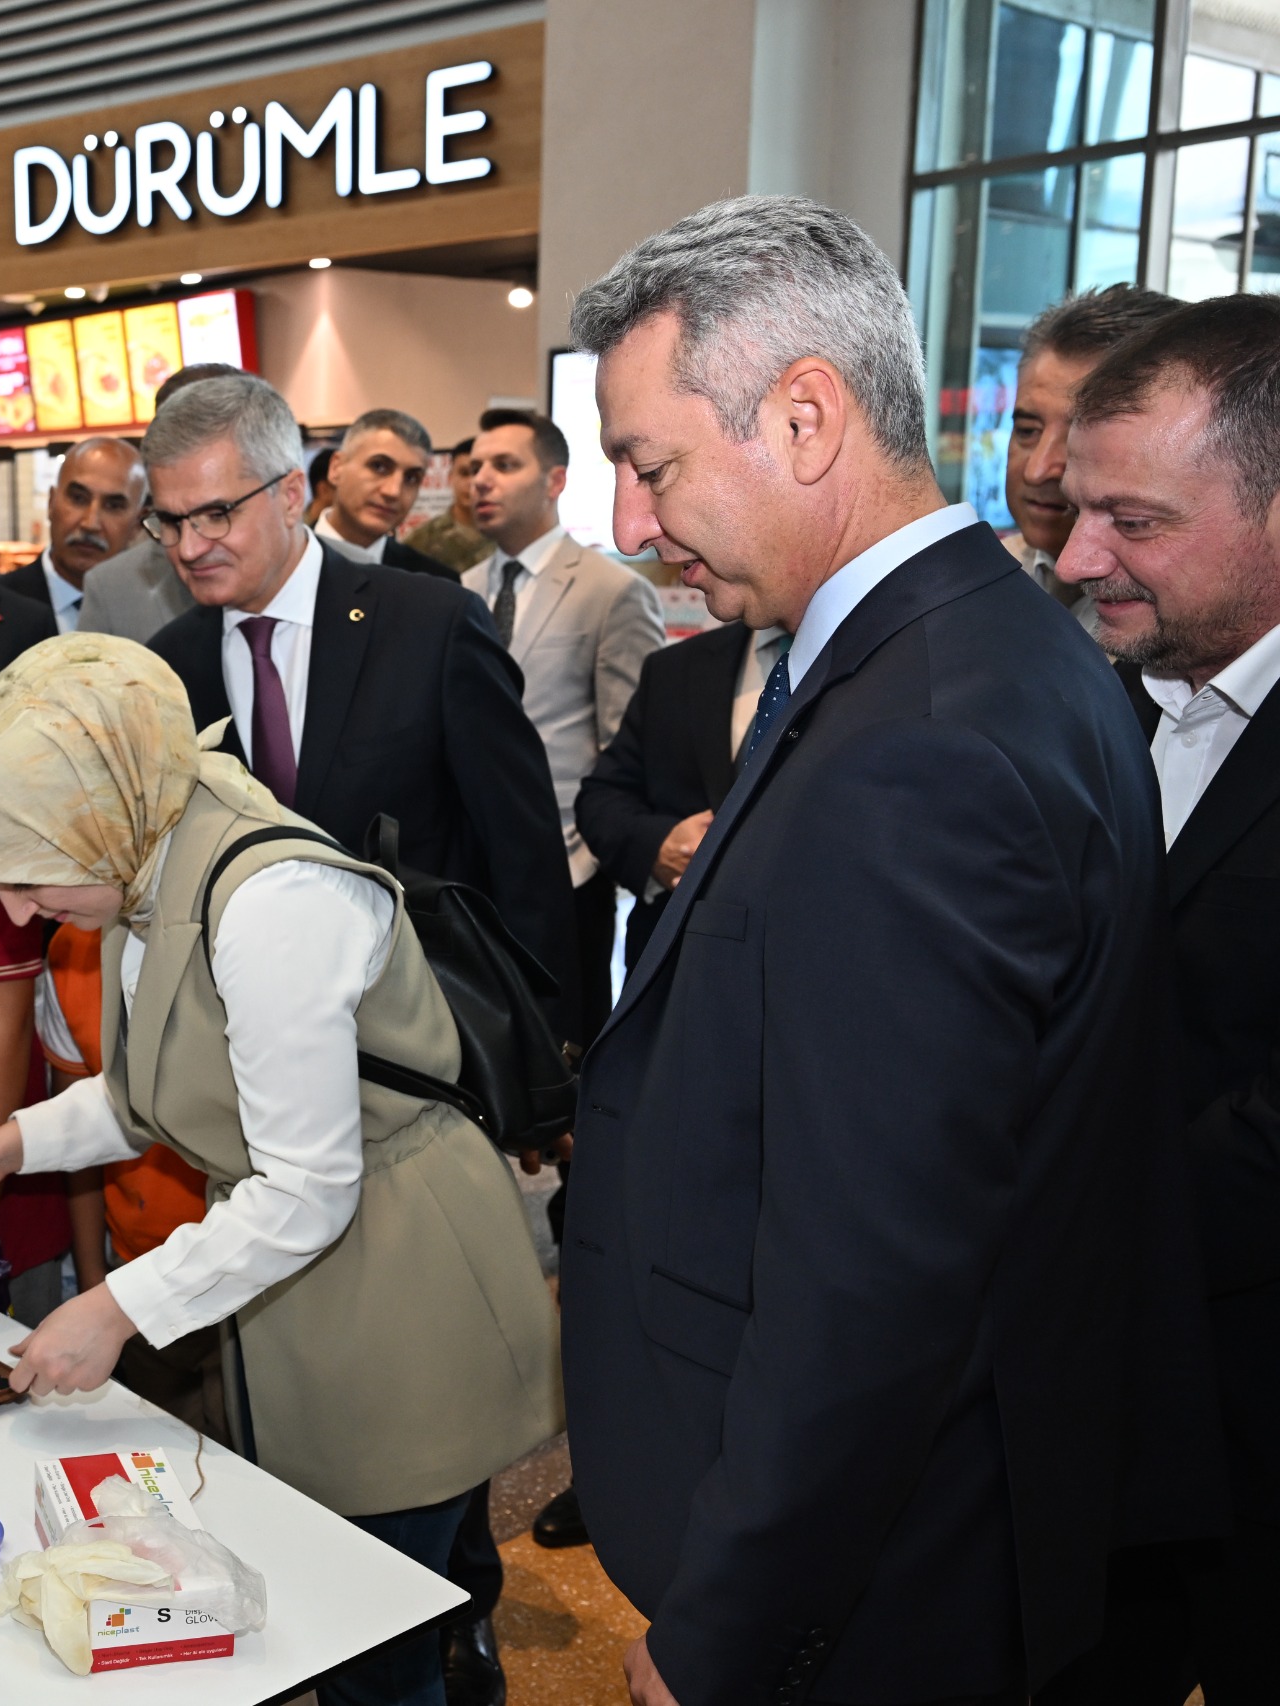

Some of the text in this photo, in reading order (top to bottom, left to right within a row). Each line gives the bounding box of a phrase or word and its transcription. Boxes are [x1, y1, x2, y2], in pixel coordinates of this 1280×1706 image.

[13, 61, 493, 246] DÜRÜMLE
[157, 1607, 172, 1623] S
[185, 1614, 218, 1625] GLOV
[97, 1626, 140, 1637] niceplast
